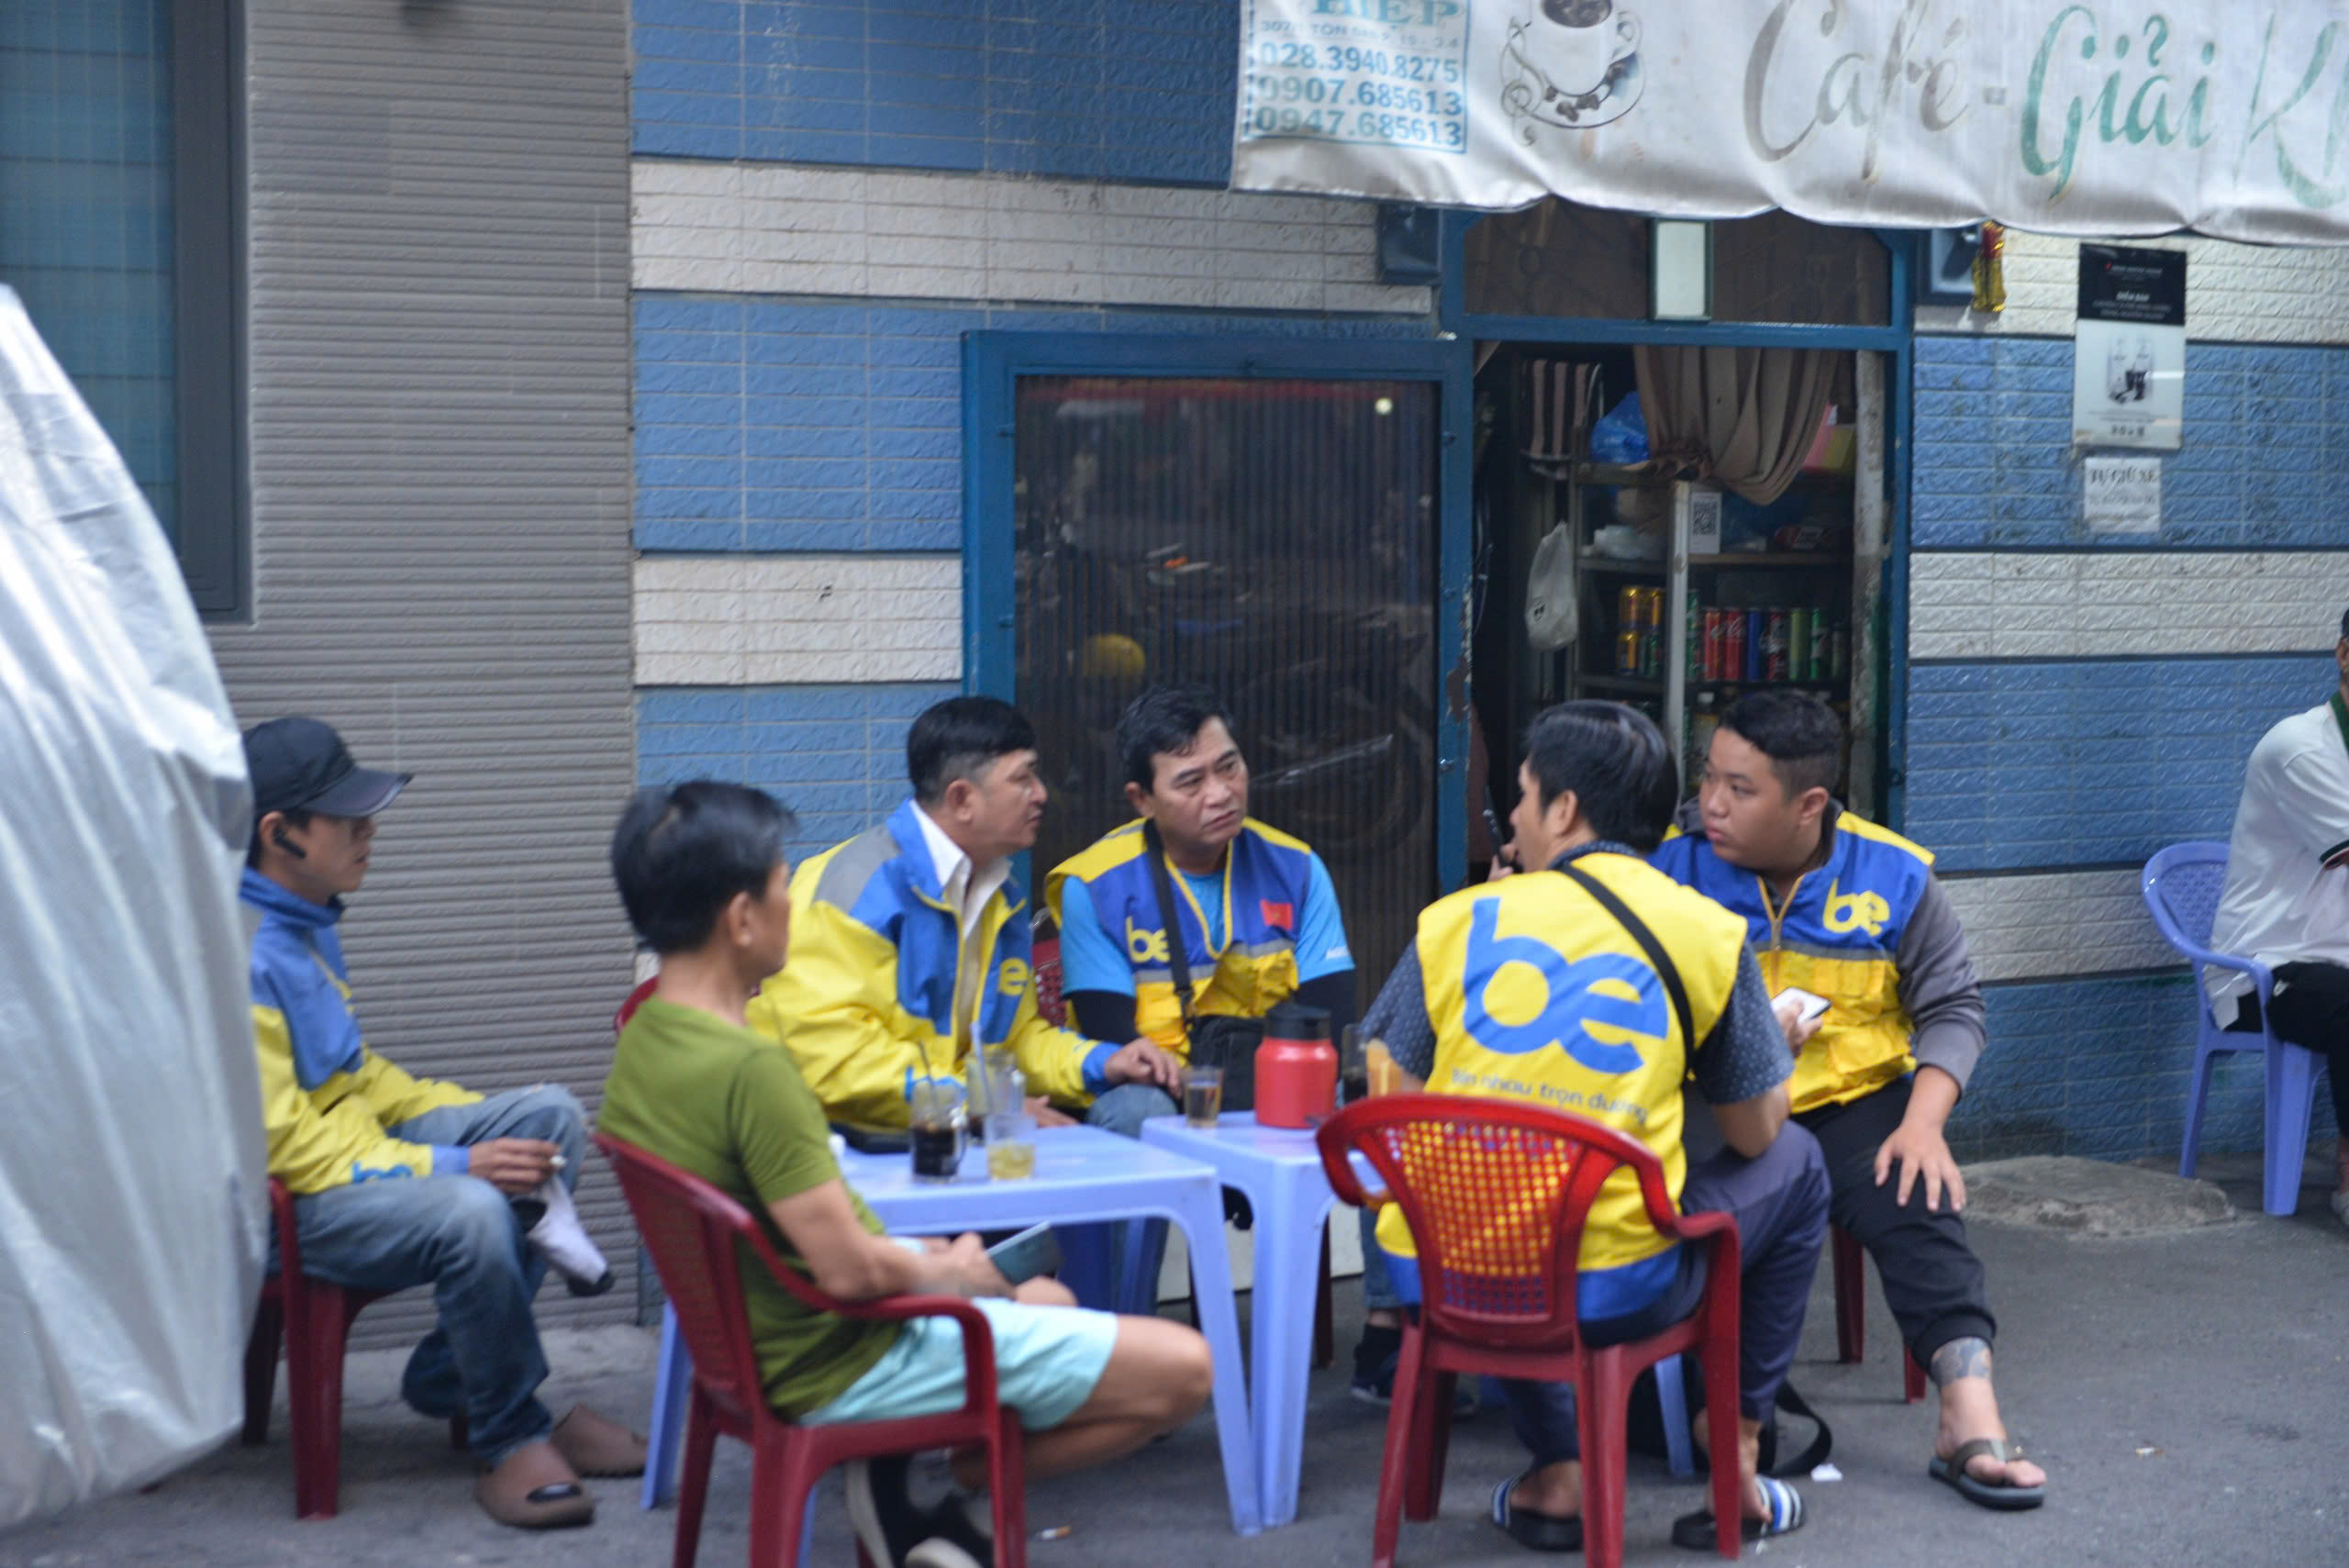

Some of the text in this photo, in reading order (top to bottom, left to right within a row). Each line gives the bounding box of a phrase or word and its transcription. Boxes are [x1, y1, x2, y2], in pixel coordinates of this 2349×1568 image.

[1254, 106, 1464, 146] 0947.685613
[1257, 75, 1464, 117] 0907.685613
[2020, 5, 2217, 204] Giải
[1822, 877, 1890, 937] be
[1462, 895, 1669, 1074] be
